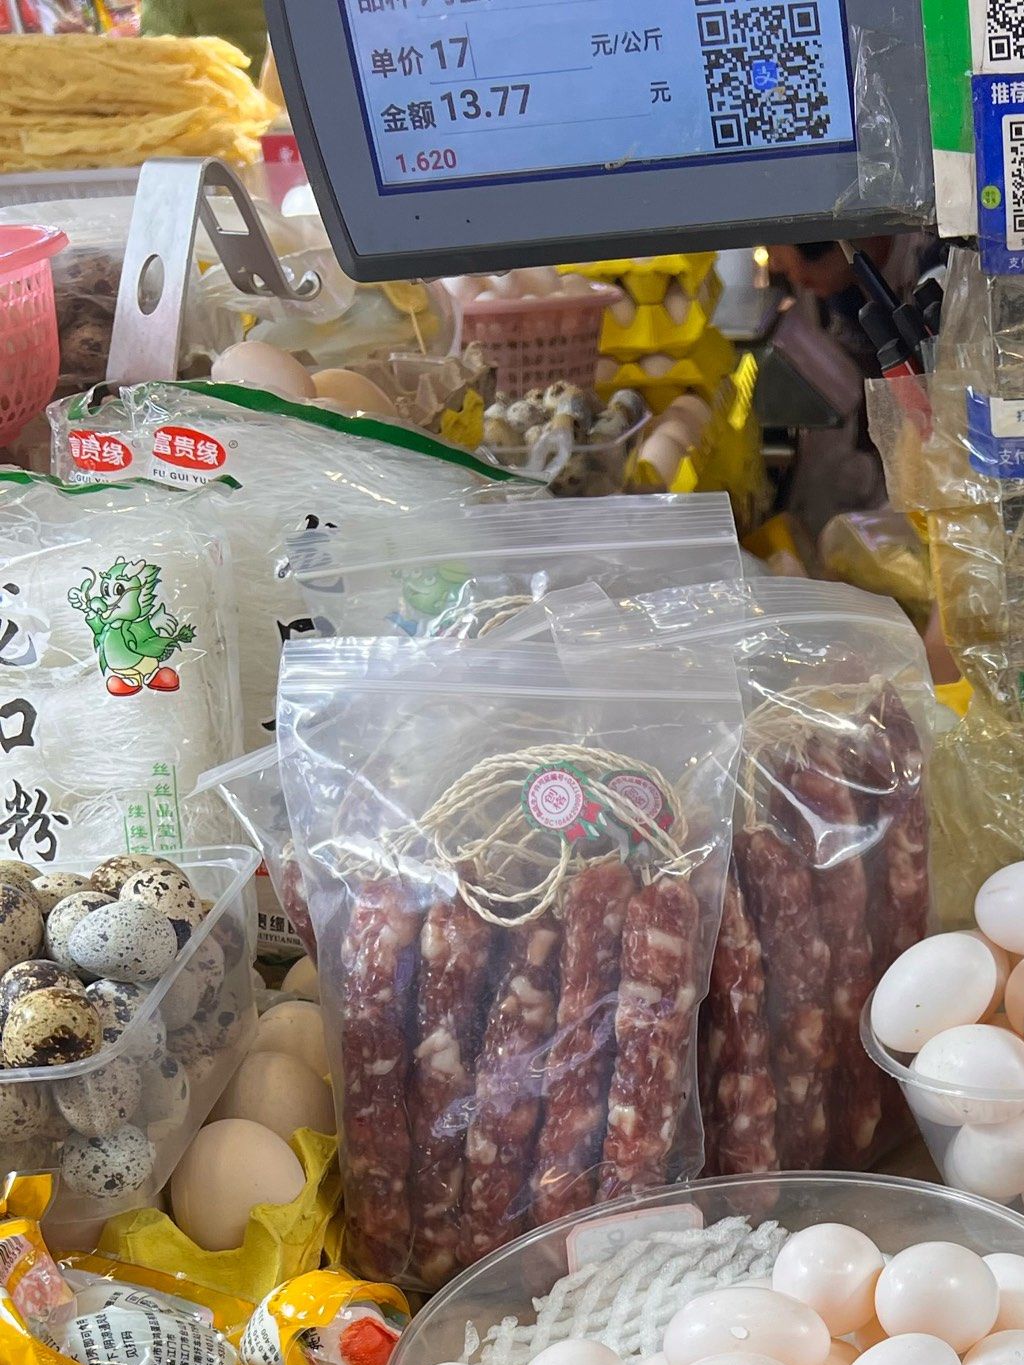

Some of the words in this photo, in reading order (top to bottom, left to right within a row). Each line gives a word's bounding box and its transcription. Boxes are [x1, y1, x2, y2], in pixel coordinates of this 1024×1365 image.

[371, 45, 424, 78] 单价
[430, 37, 468, 71] 17
[591, 27, 663, 56] 元/公斤
[381, 100, 437, 134] 金额
[439, 84, 531, 121] 13.77
[650, 80, 671, 104] 元
[396, 148, 457, 174] 1.620
[153, 431, 218, 466] 富贵缘
[153, 468, 166, 478] FU
[170, 472, 189, 482] GUI
[193, 475, 211, 485] YU
[121, 1331, 139, 1359] 见打码
